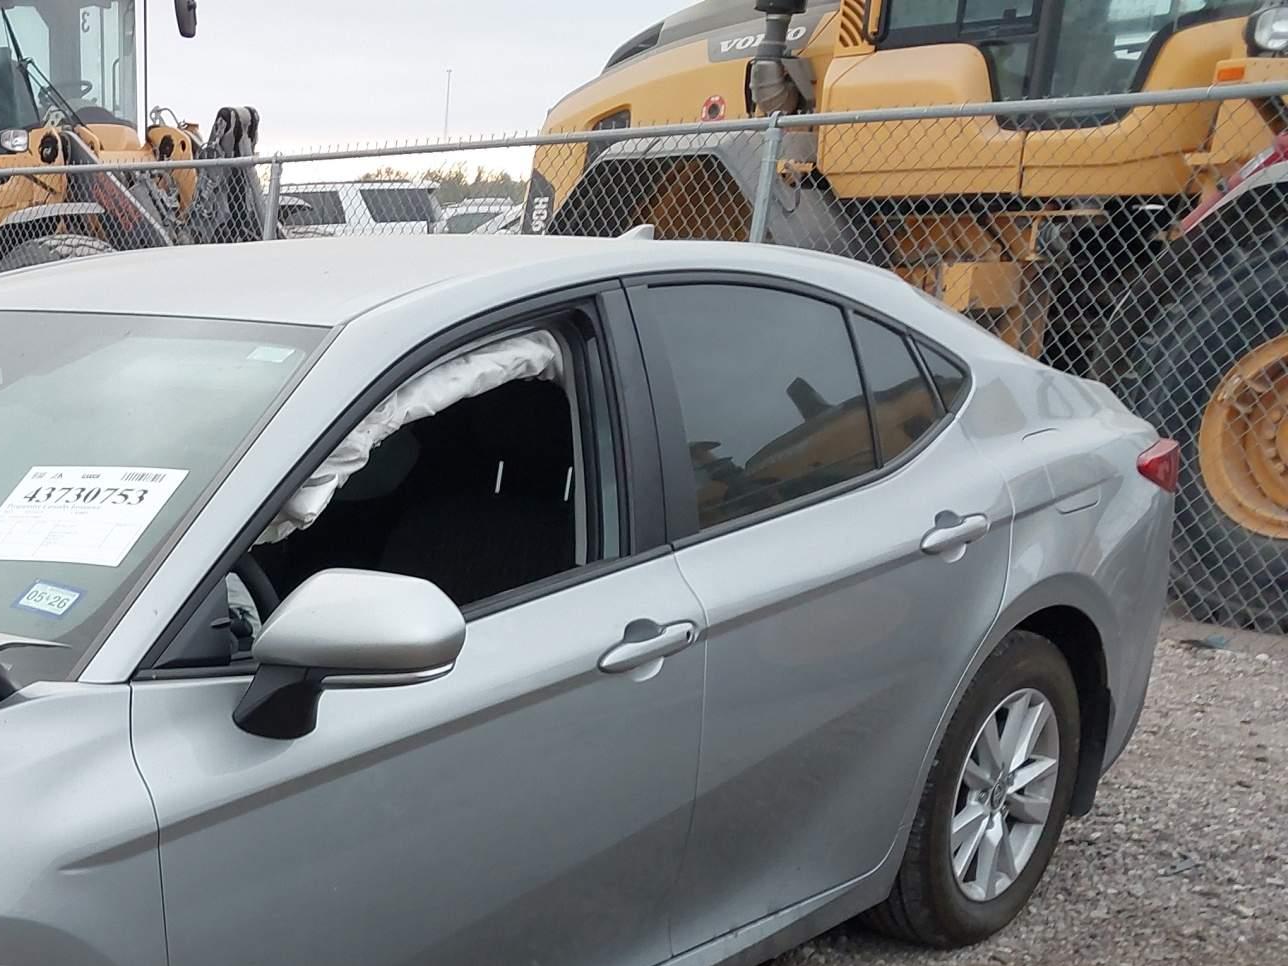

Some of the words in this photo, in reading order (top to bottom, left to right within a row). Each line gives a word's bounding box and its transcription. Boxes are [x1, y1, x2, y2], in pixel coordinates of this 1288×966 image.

[720, 26, 807, 53] VOLO
[531, 196, 549, 235] 90H
[23, 486, 149, 506] 43730753
